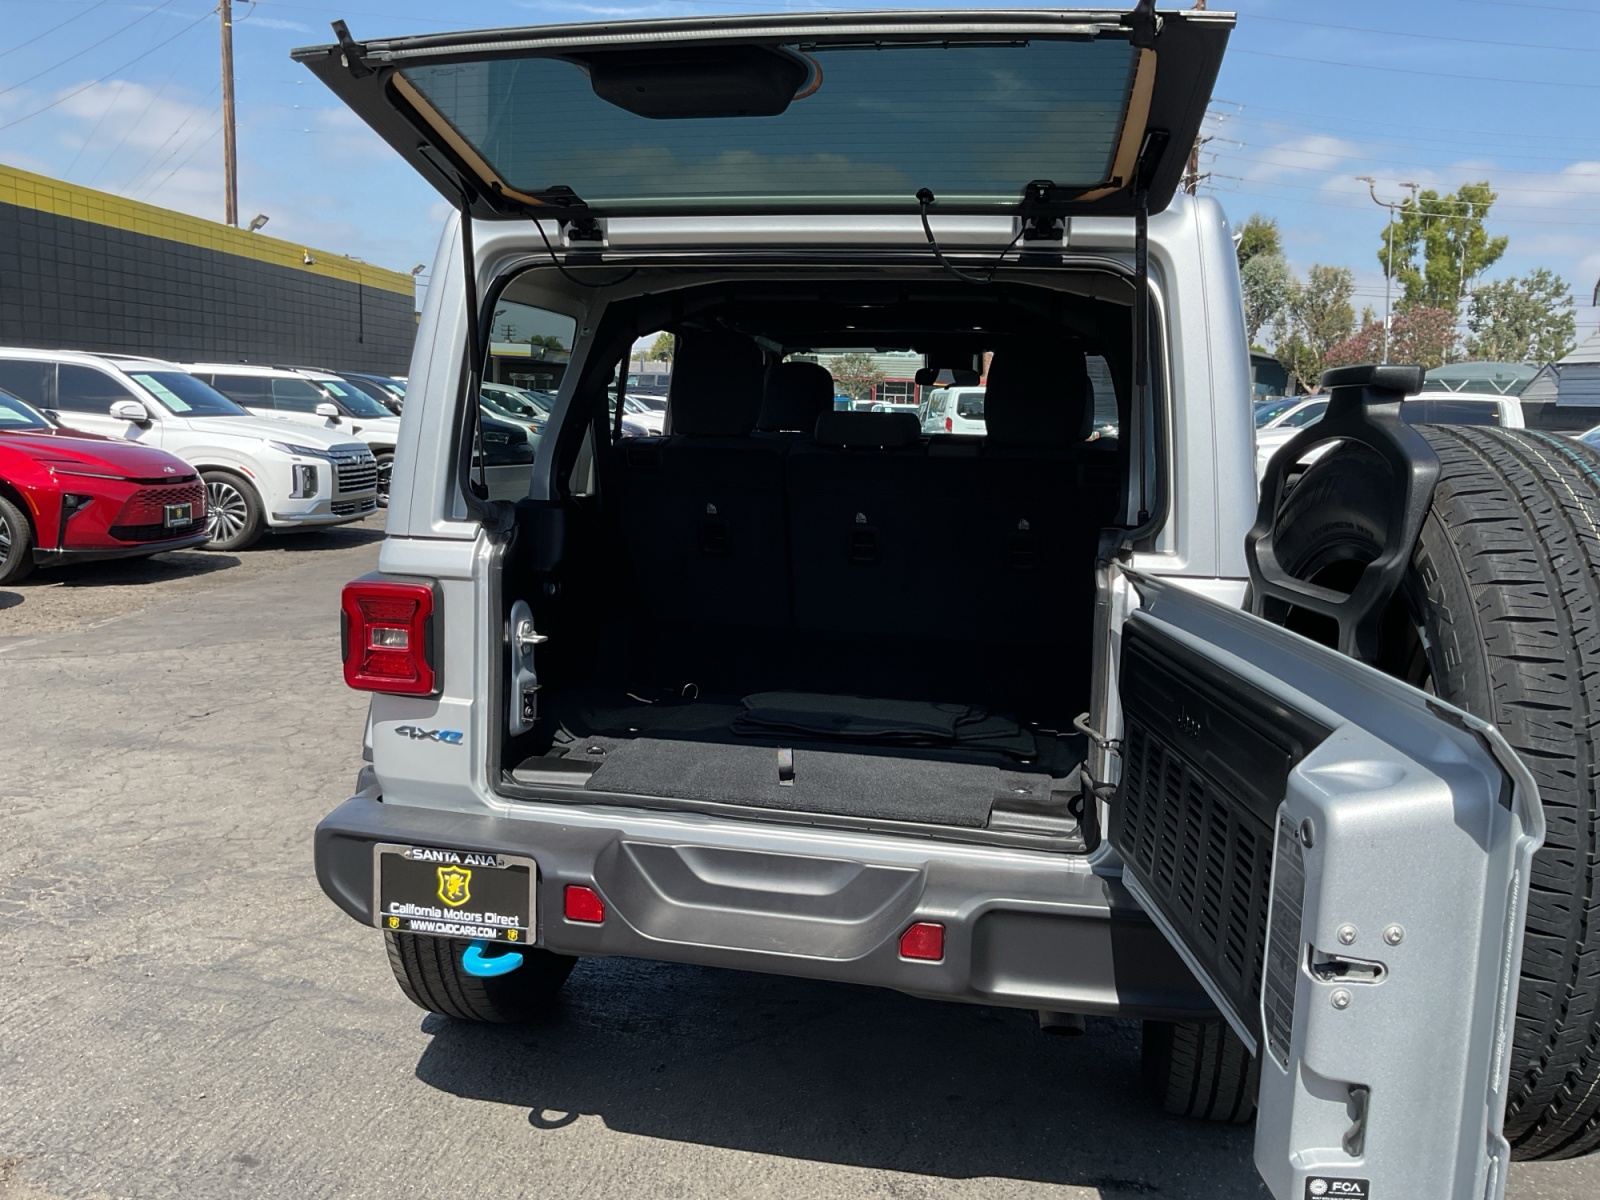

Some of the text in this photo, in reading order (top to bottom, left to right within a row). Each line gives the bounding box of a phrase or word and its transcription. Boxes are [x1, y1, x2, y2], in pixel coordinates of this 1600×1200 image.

[412, 848, 497, 867] SANTA ANA
[389, 902, 520, 926] California Motors Direct
[410, 919, 497, 938] WWW.CMDCARS.COM
[1332, 1181, 1361, 1192] FCA
